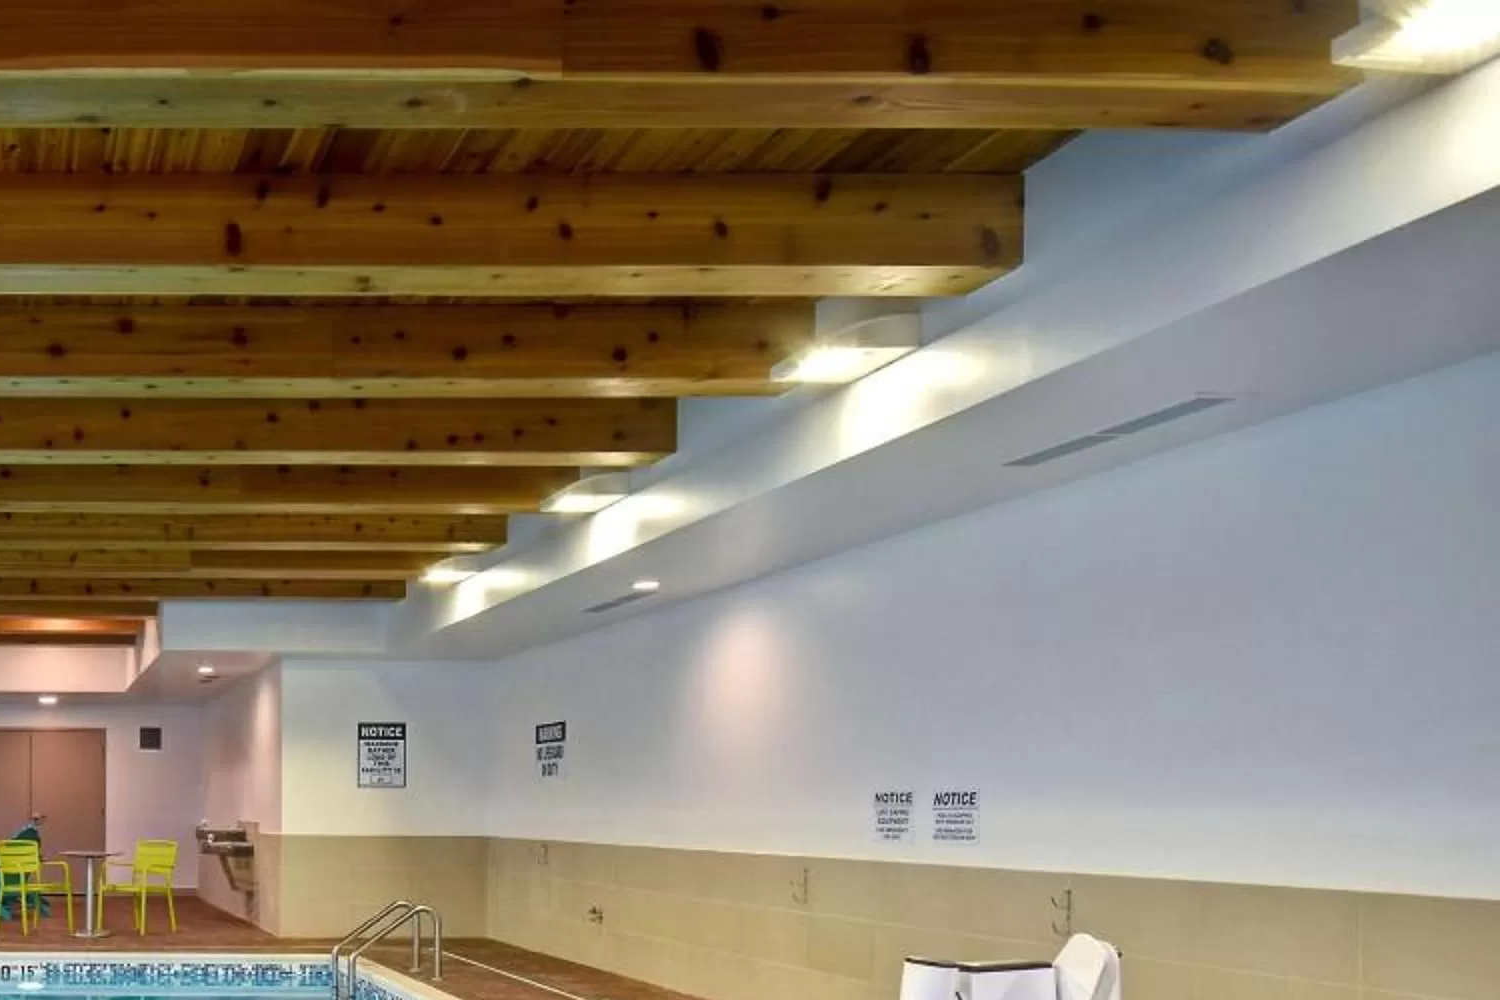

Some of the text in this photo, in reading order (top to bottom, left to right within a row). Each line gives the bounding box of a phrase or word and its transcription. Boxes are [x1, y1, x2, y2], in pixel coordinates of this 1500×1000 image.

[361, 727, 403, 737] NOTICE
[875, 791, 913, 804] NOTICE
[933, 791, 977, 806] NOTICE
